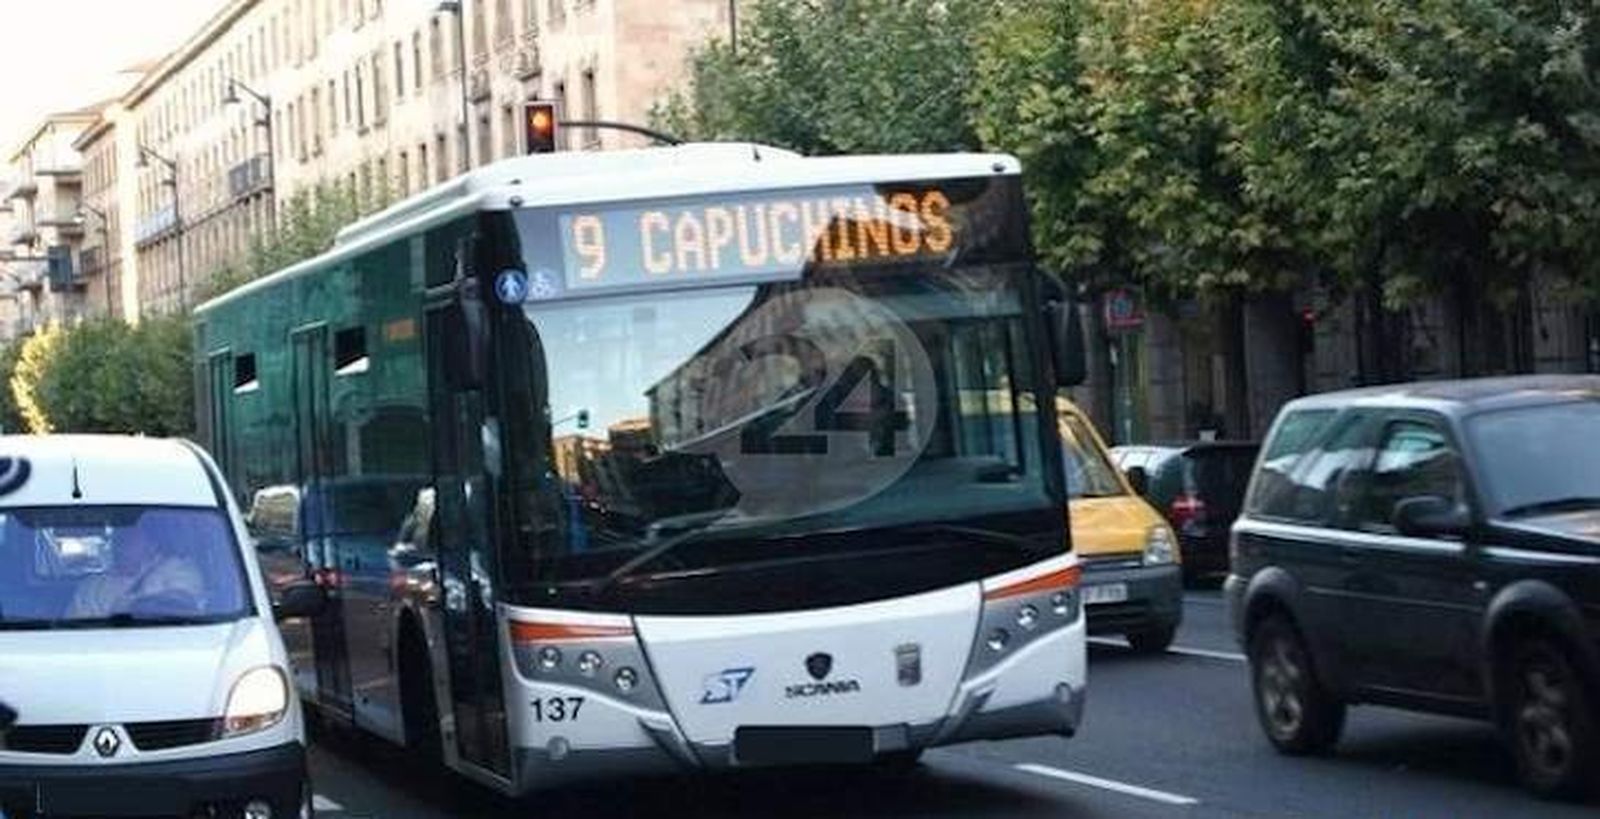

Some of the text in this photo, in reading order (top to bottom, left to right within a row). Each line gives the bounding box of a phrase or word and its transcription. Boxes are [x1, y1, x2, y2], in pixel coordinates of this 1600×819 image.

[571, 189, 953, 279] 9 CAPUCHINOS
[784, 679, 861, 699] SCANIA
[530, 696, 585, 722] 137
